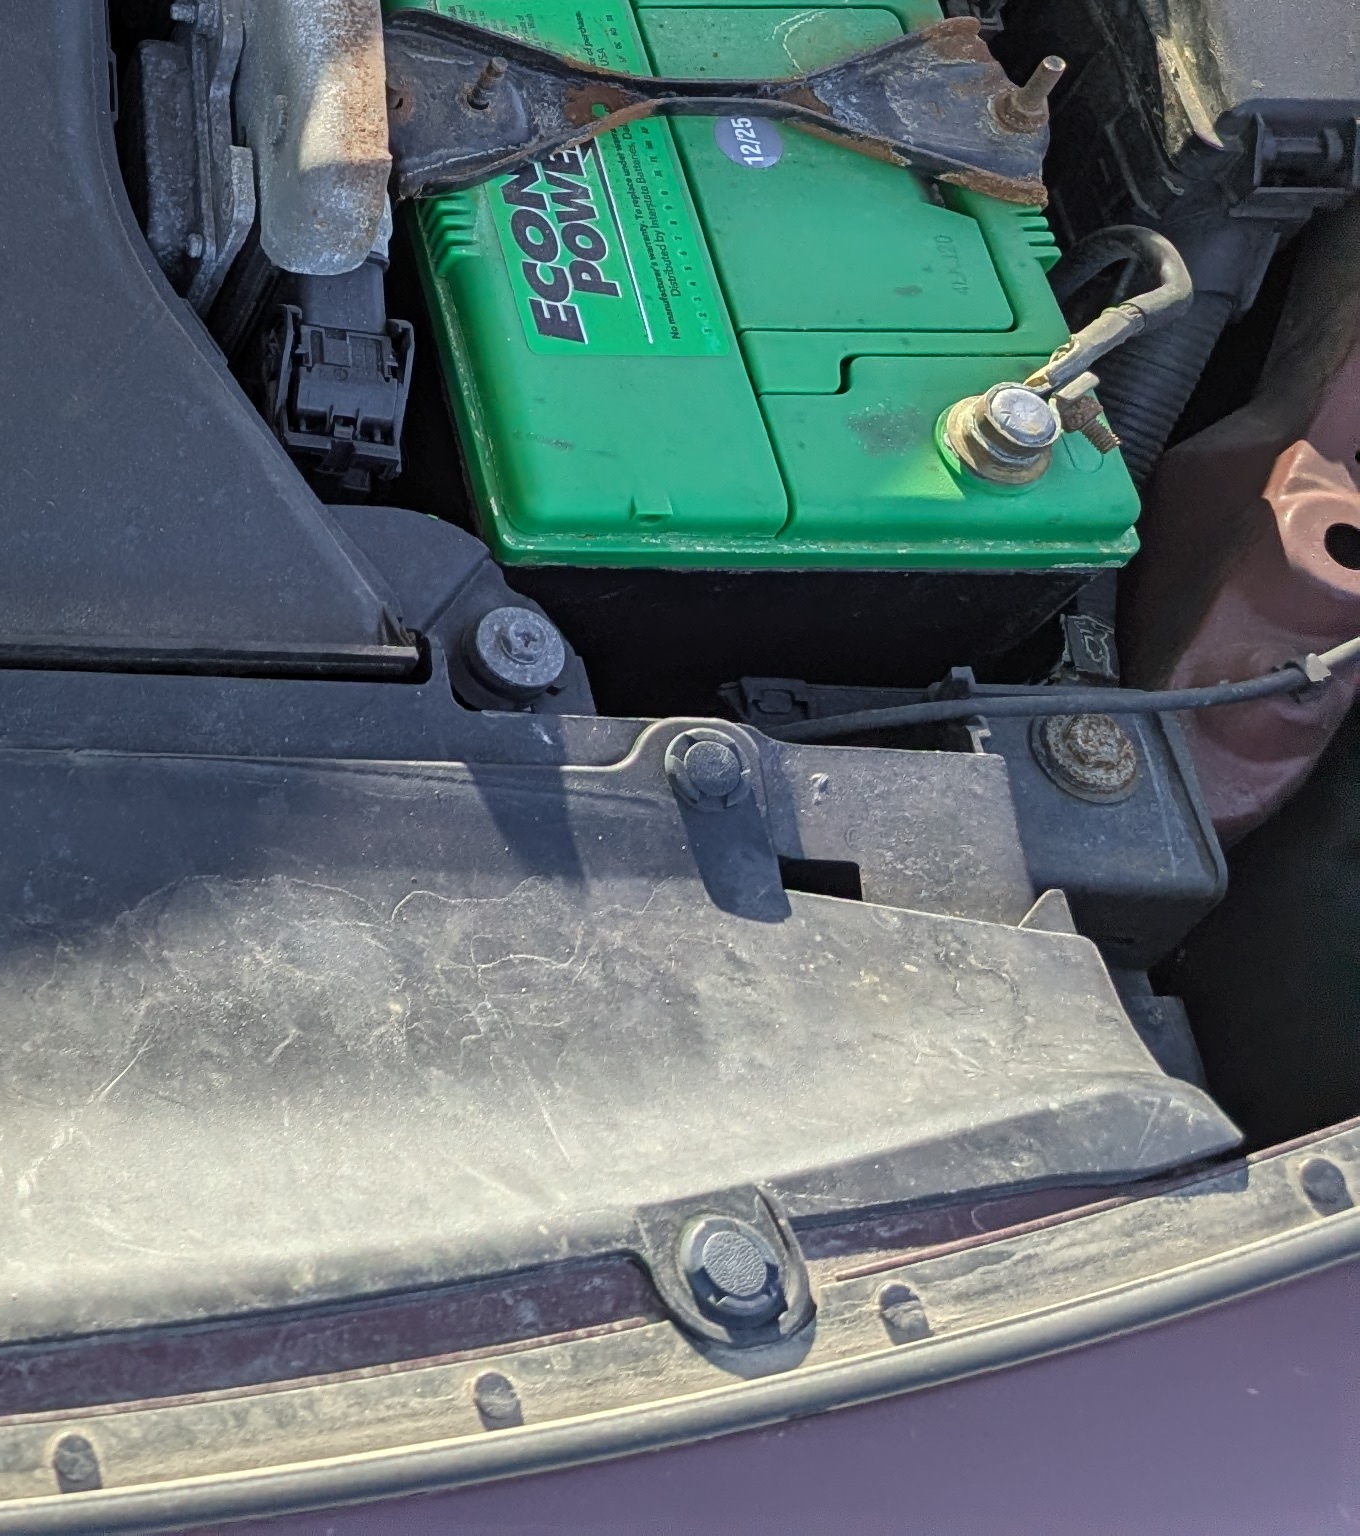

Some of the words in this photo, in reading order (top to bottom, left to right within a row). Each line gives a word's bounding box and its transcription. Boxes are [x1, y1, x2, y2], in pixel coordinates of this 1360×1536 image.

[731, 117, 764, 166] 12/25
[657, 230, 667, 242] by
[662, 242, 682, 297] Distributed
[671, 324, 681, 340] No
